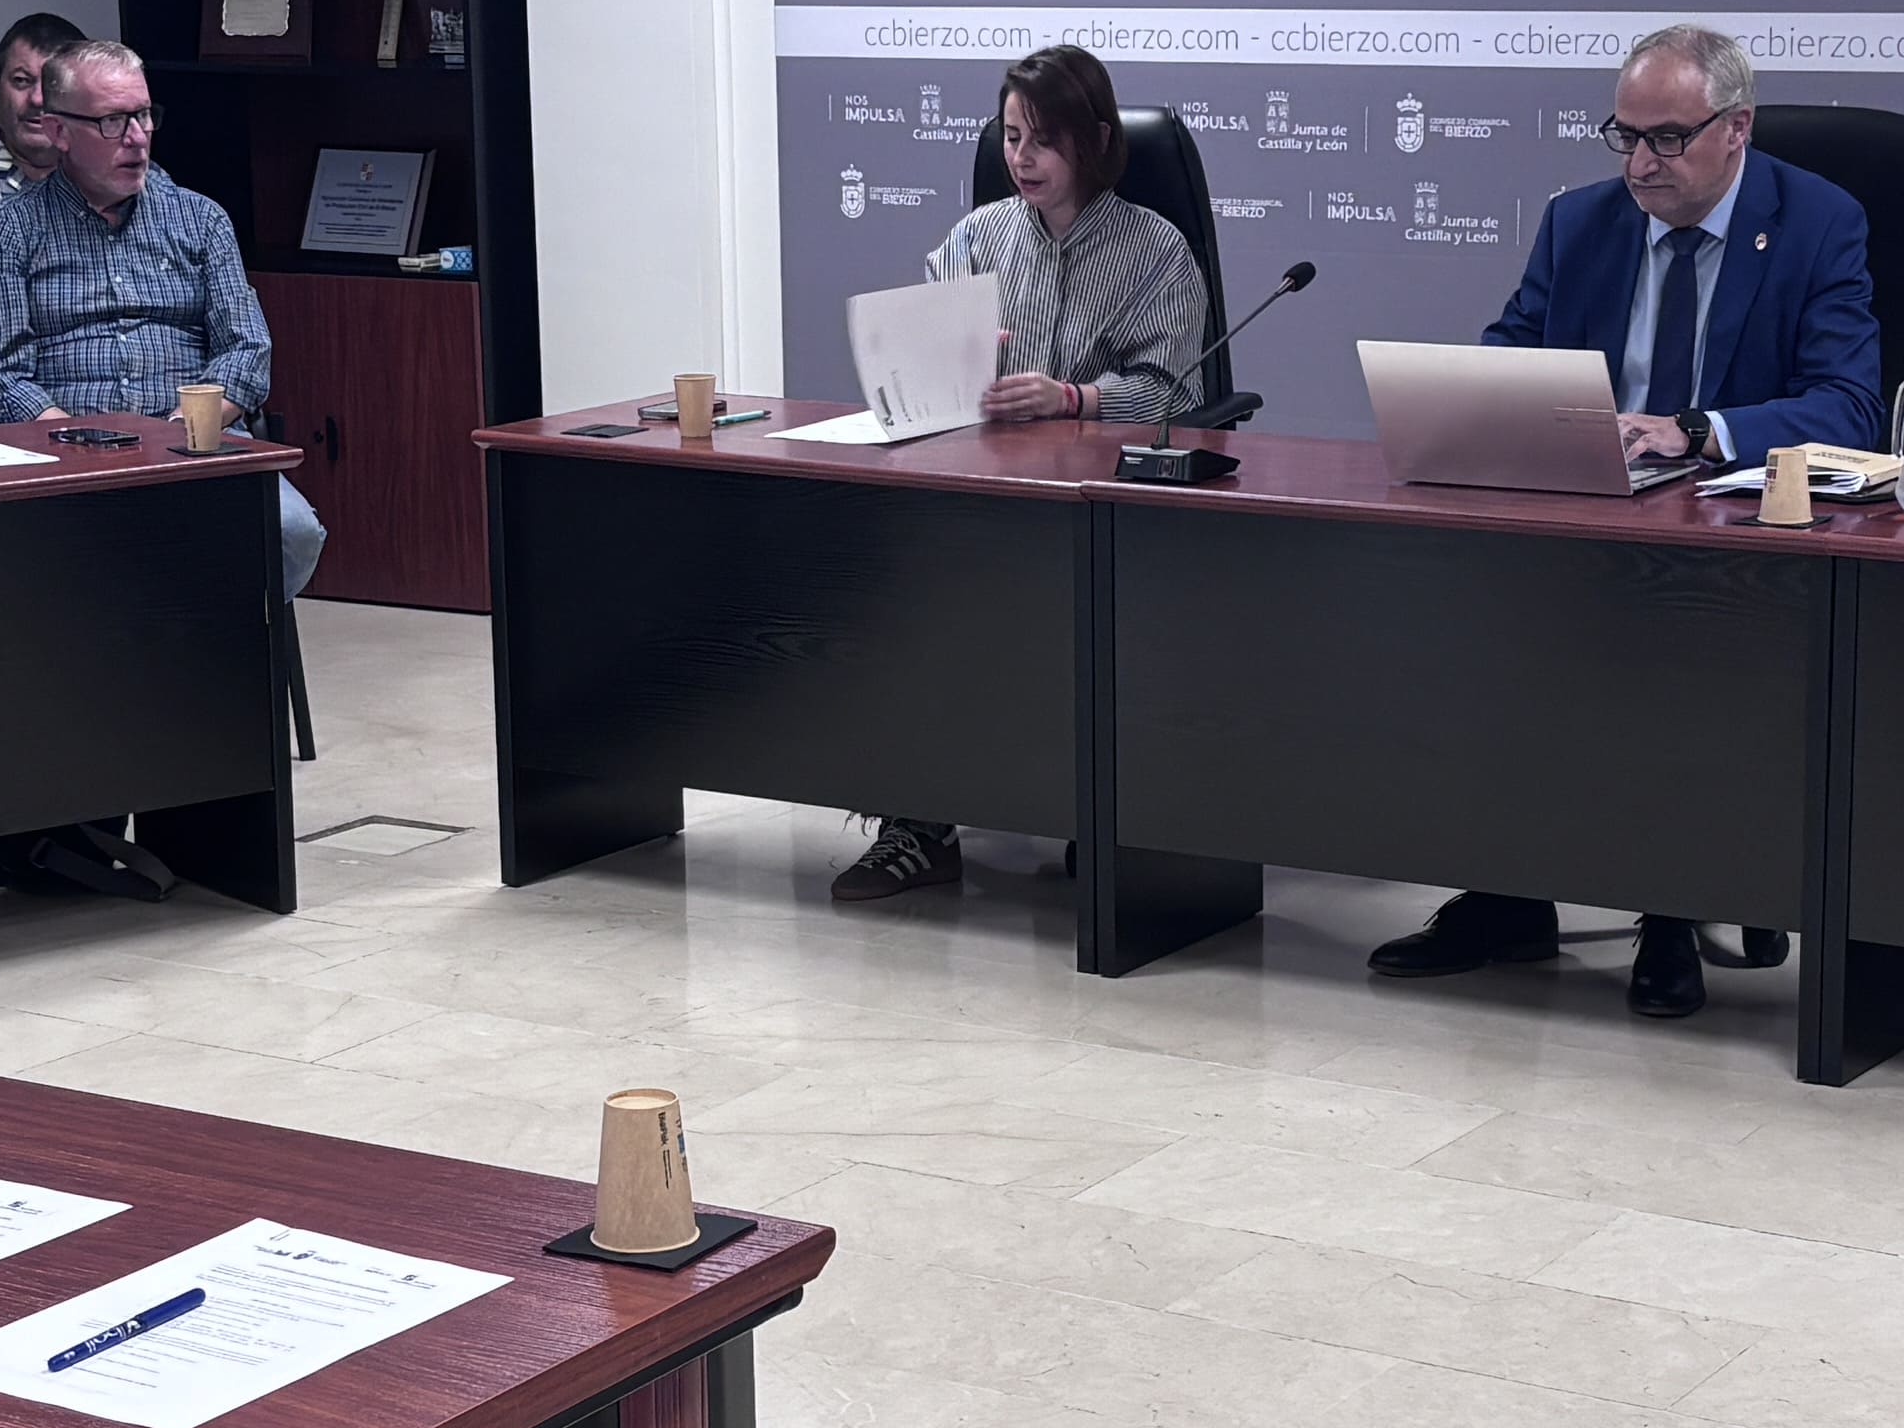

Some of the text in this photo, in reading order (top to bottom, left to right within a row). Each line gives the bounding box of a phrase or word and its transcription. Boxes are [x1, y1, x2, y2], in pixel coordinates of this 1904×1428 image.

[864, 18, 1033, 49] ccbierzo.com
[1060, 18, 1241, 52] ccbierzo.com
[1271, 21, 1461, 54] ccbierzo.com
[1494, 24, 1645, 56] ccbierzo.c
[1327, 192, 1355, 204] NOS
[1327, 204, 1396, 223] IMPULSA
[1441, 215, 1499, 229] Junta de
[1405, 228, 1499, 246] Castilla y León
